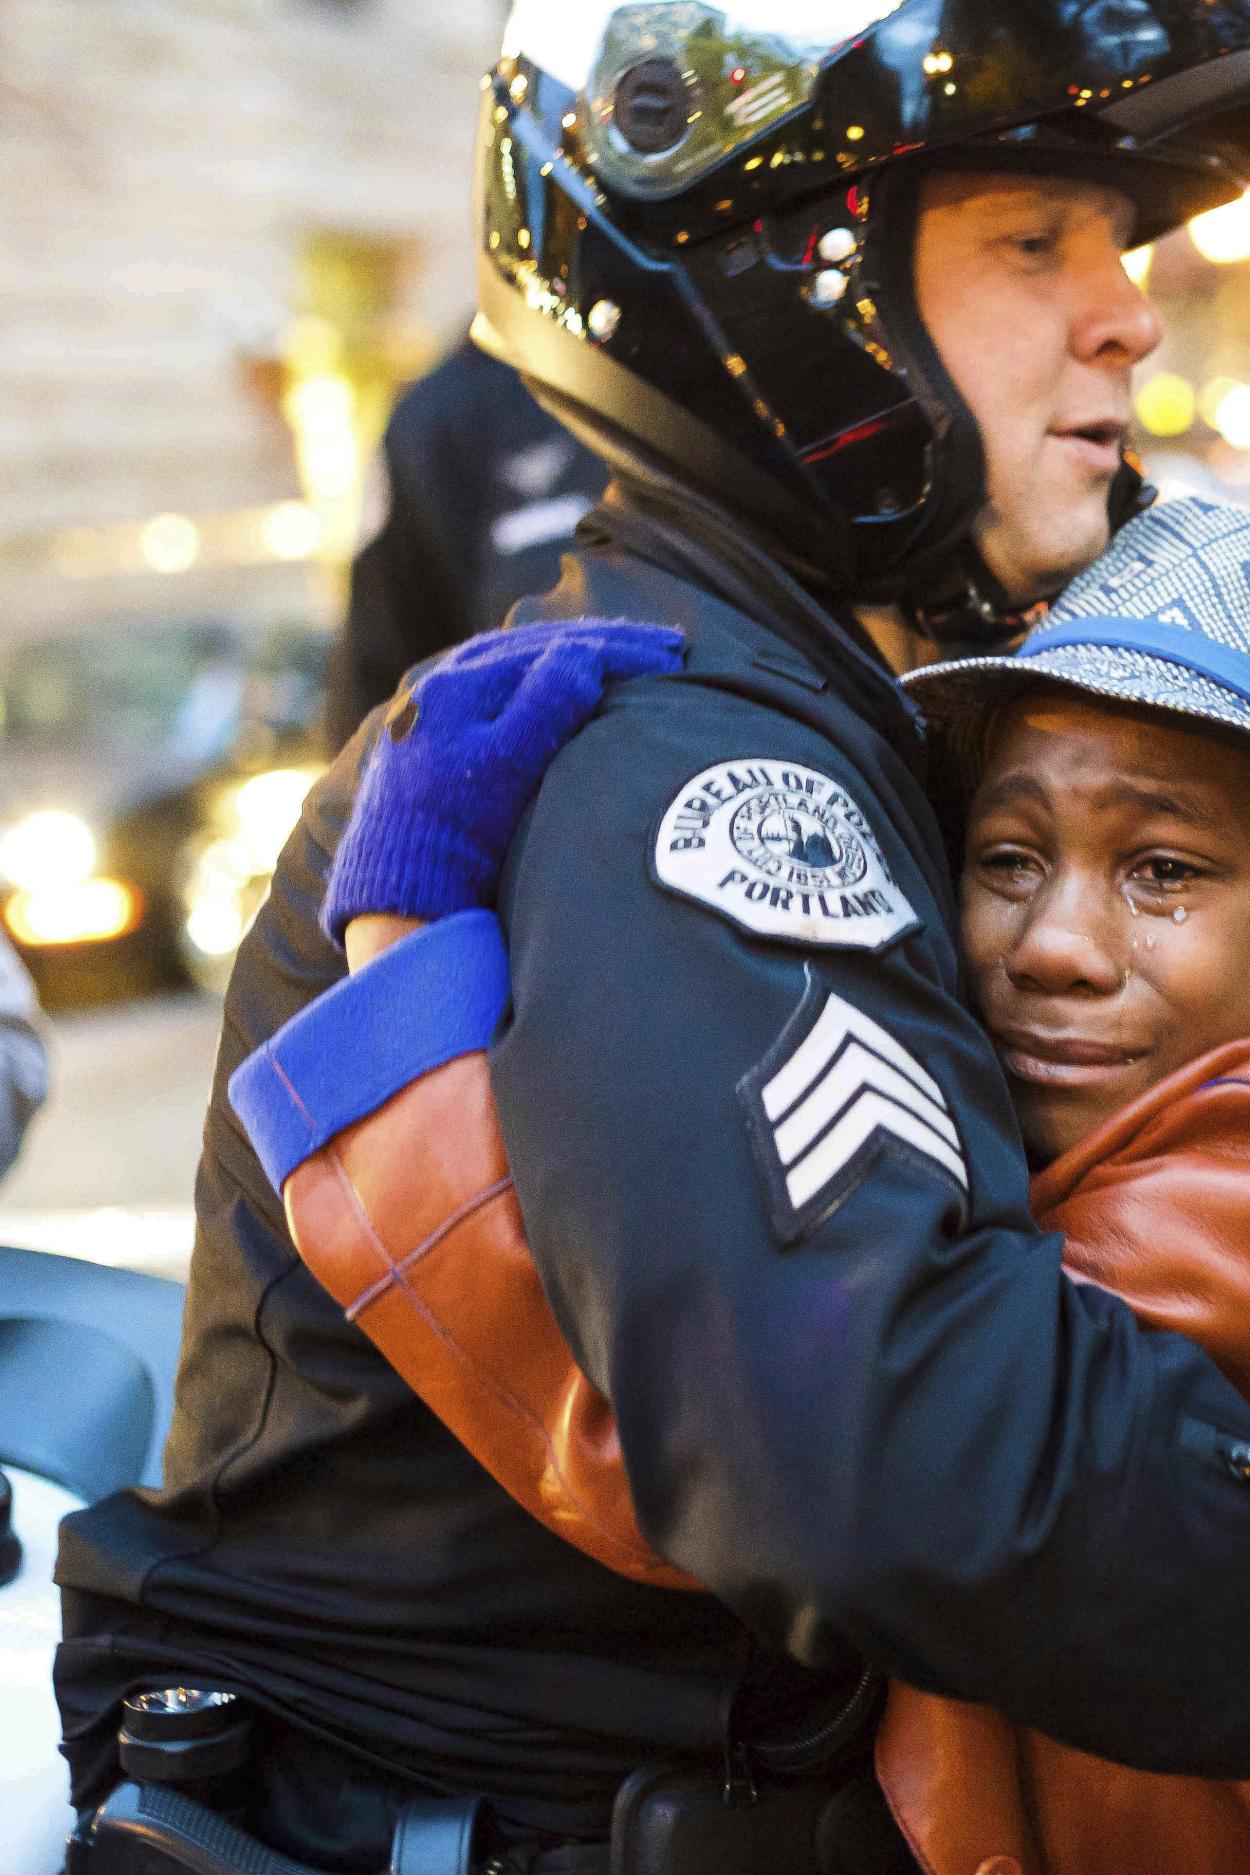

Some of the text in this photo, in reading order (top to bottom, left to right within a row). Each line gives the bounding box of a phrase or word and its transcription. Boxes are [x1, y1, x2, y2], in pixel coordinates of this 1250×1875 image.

[669, 768, 774, 852] BUREAU
[781, 771, 826, 799] OF
[718, 868, 894, 917] PORTLAND
